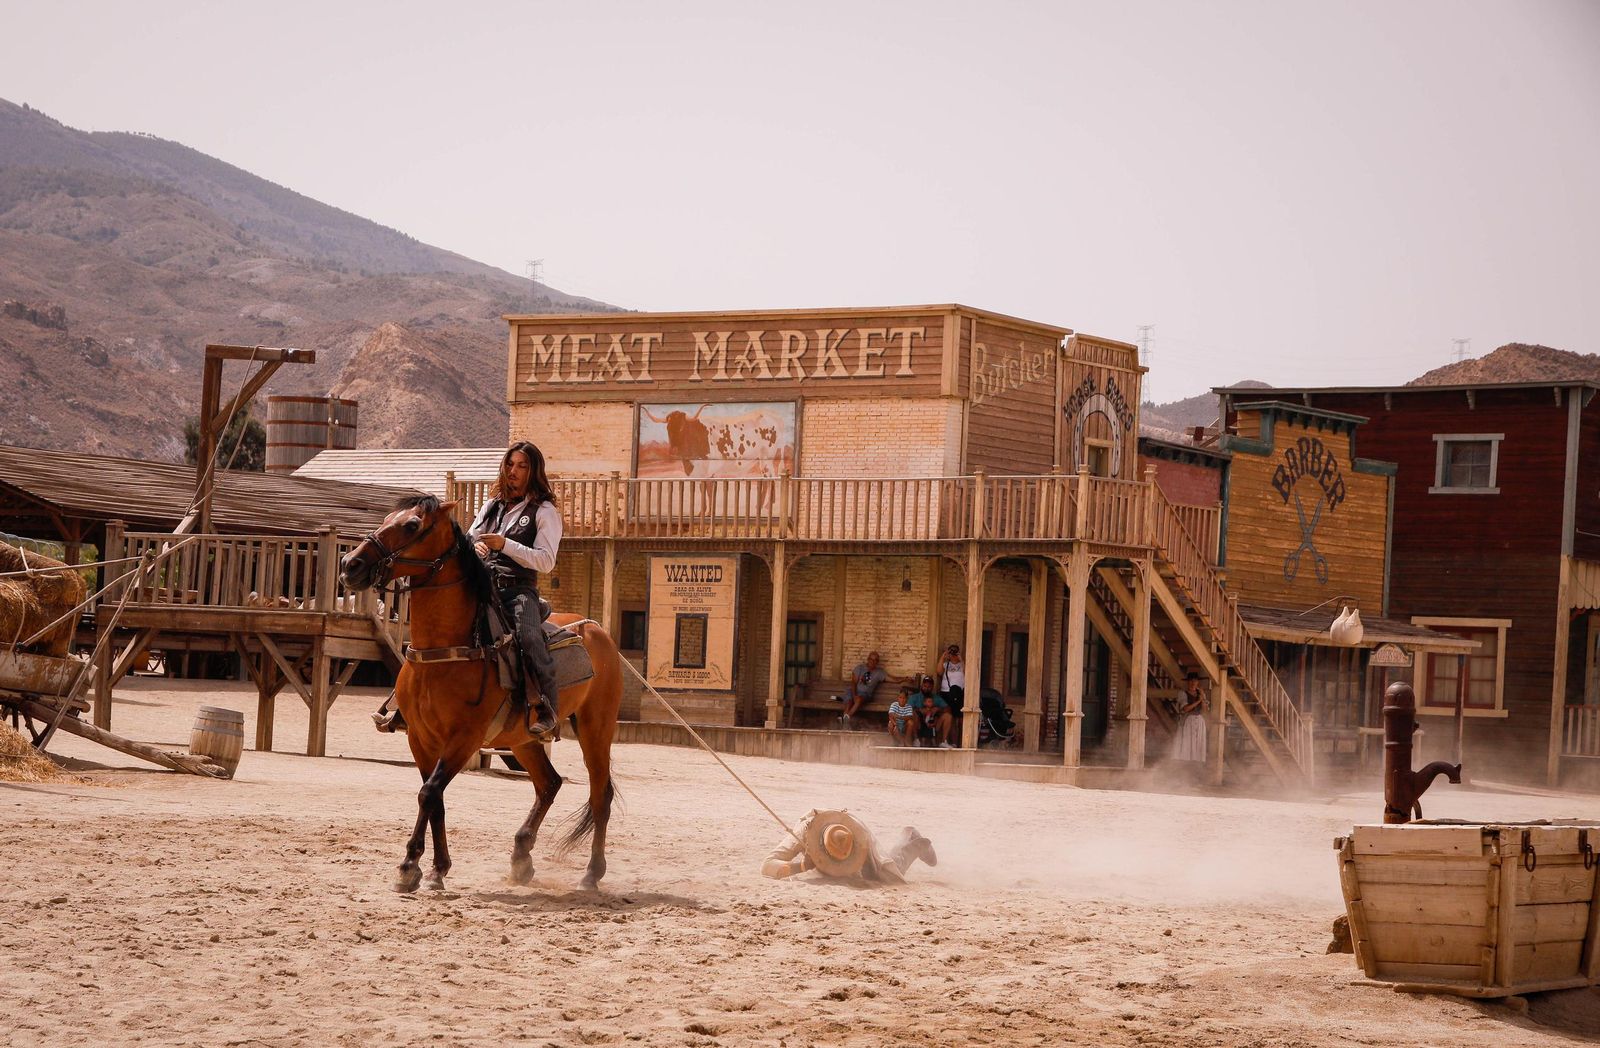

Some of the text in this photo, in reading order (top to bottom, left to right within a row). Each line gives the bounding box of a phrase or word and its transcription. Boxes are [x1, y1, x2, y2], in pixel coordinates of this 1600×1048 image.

[526, 326, 927, 385] MEAT MARKET
[972, 341, 1055, 405] Butcher
[1063, 372, 1133, 432] HORSE SHOES
[1271, 436, 1346, 513] BARBER
[664, 564, 723, 583] WANTED
